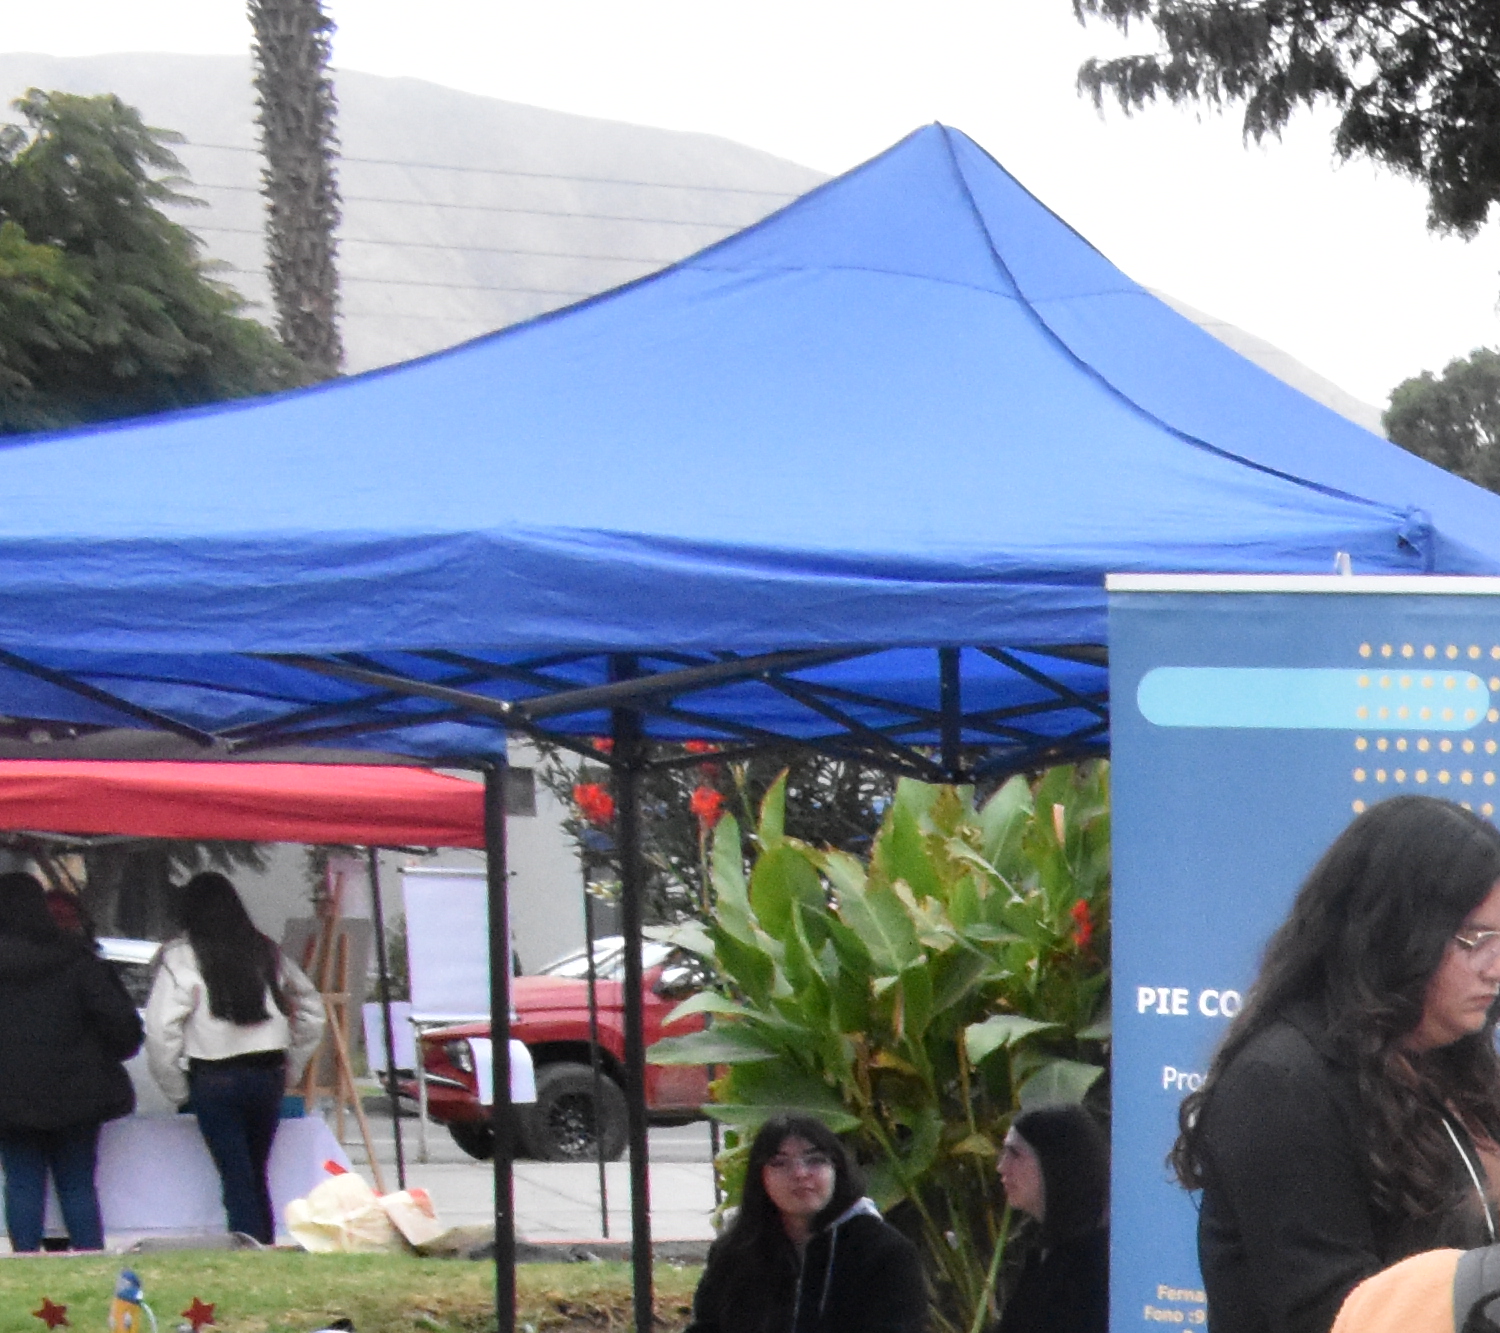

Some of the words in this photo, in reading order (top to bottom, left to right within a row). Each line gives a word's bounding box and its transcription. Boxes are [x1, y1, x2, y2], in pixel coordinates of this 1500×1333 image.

[1138, 987, 1189, 1015] PIE
[1163, 1066, 1208, 1092] Pro
[1144, 1305, 1184, 1322] Fono
